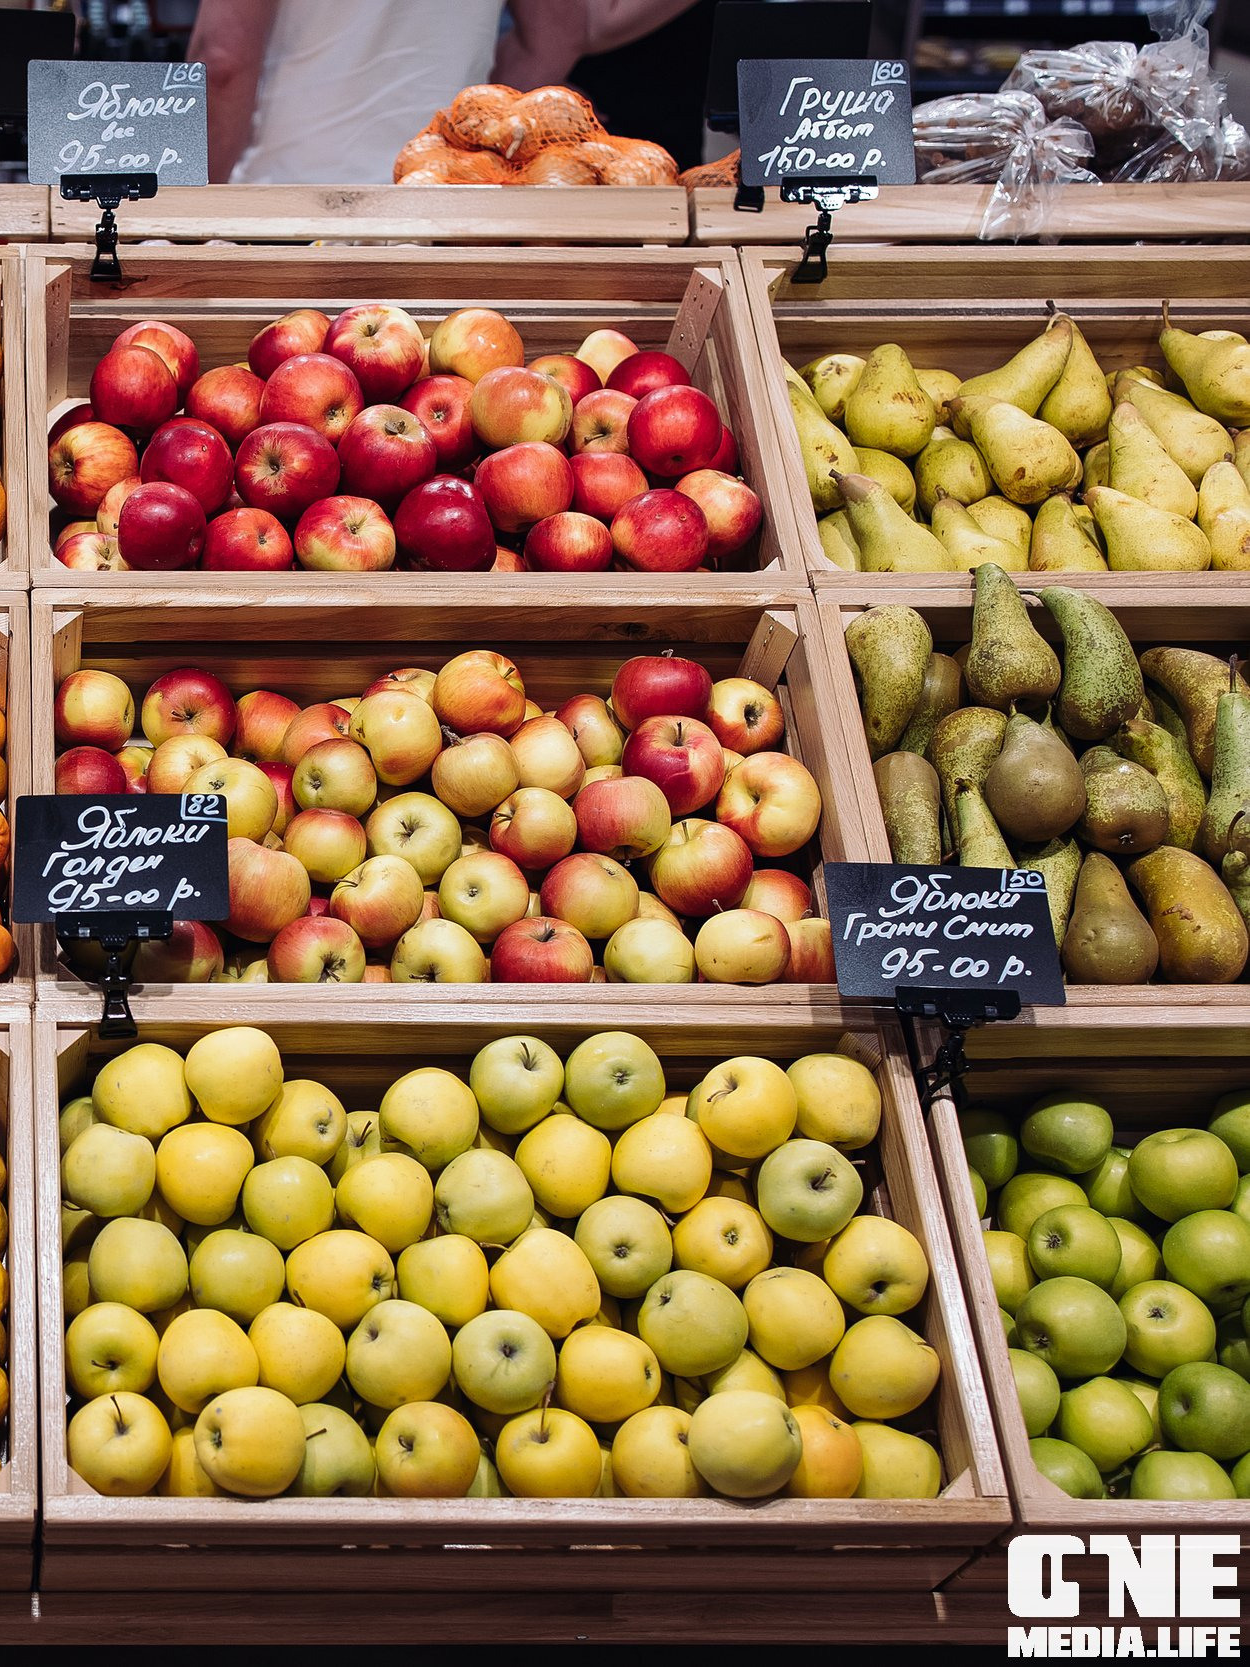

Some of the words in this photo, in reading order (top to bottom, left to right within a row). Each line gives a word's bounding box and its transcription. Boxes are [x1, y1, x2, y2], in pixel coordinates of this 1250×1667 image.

[172, 62, 203, 82] 66
[876, 62, 904, 80] 60
[67, 81, 196, 121] Яблоки
[779, 76, 895, 119] Груша
[101, 121, 135, 142] вес
[784, 117, 874, 144] Аббат
[53, 139, 150, 174] 95-00
[758, 145, 855, 177] 150-00
[187, 794, 220, 815] 82
[60, 805, 210, 850] Яблоки
[42, 851, 164, 887] Голден
[1010, 869, 1043, 888] 50
[48, 879, 160, 913] 95-00
[878, 873, 1020, 917] Яблоки
[843, 913, 938, 946] Грани
[943, 914, 1034, 940] Смит
[882, 947, 990, 979] 95-00
